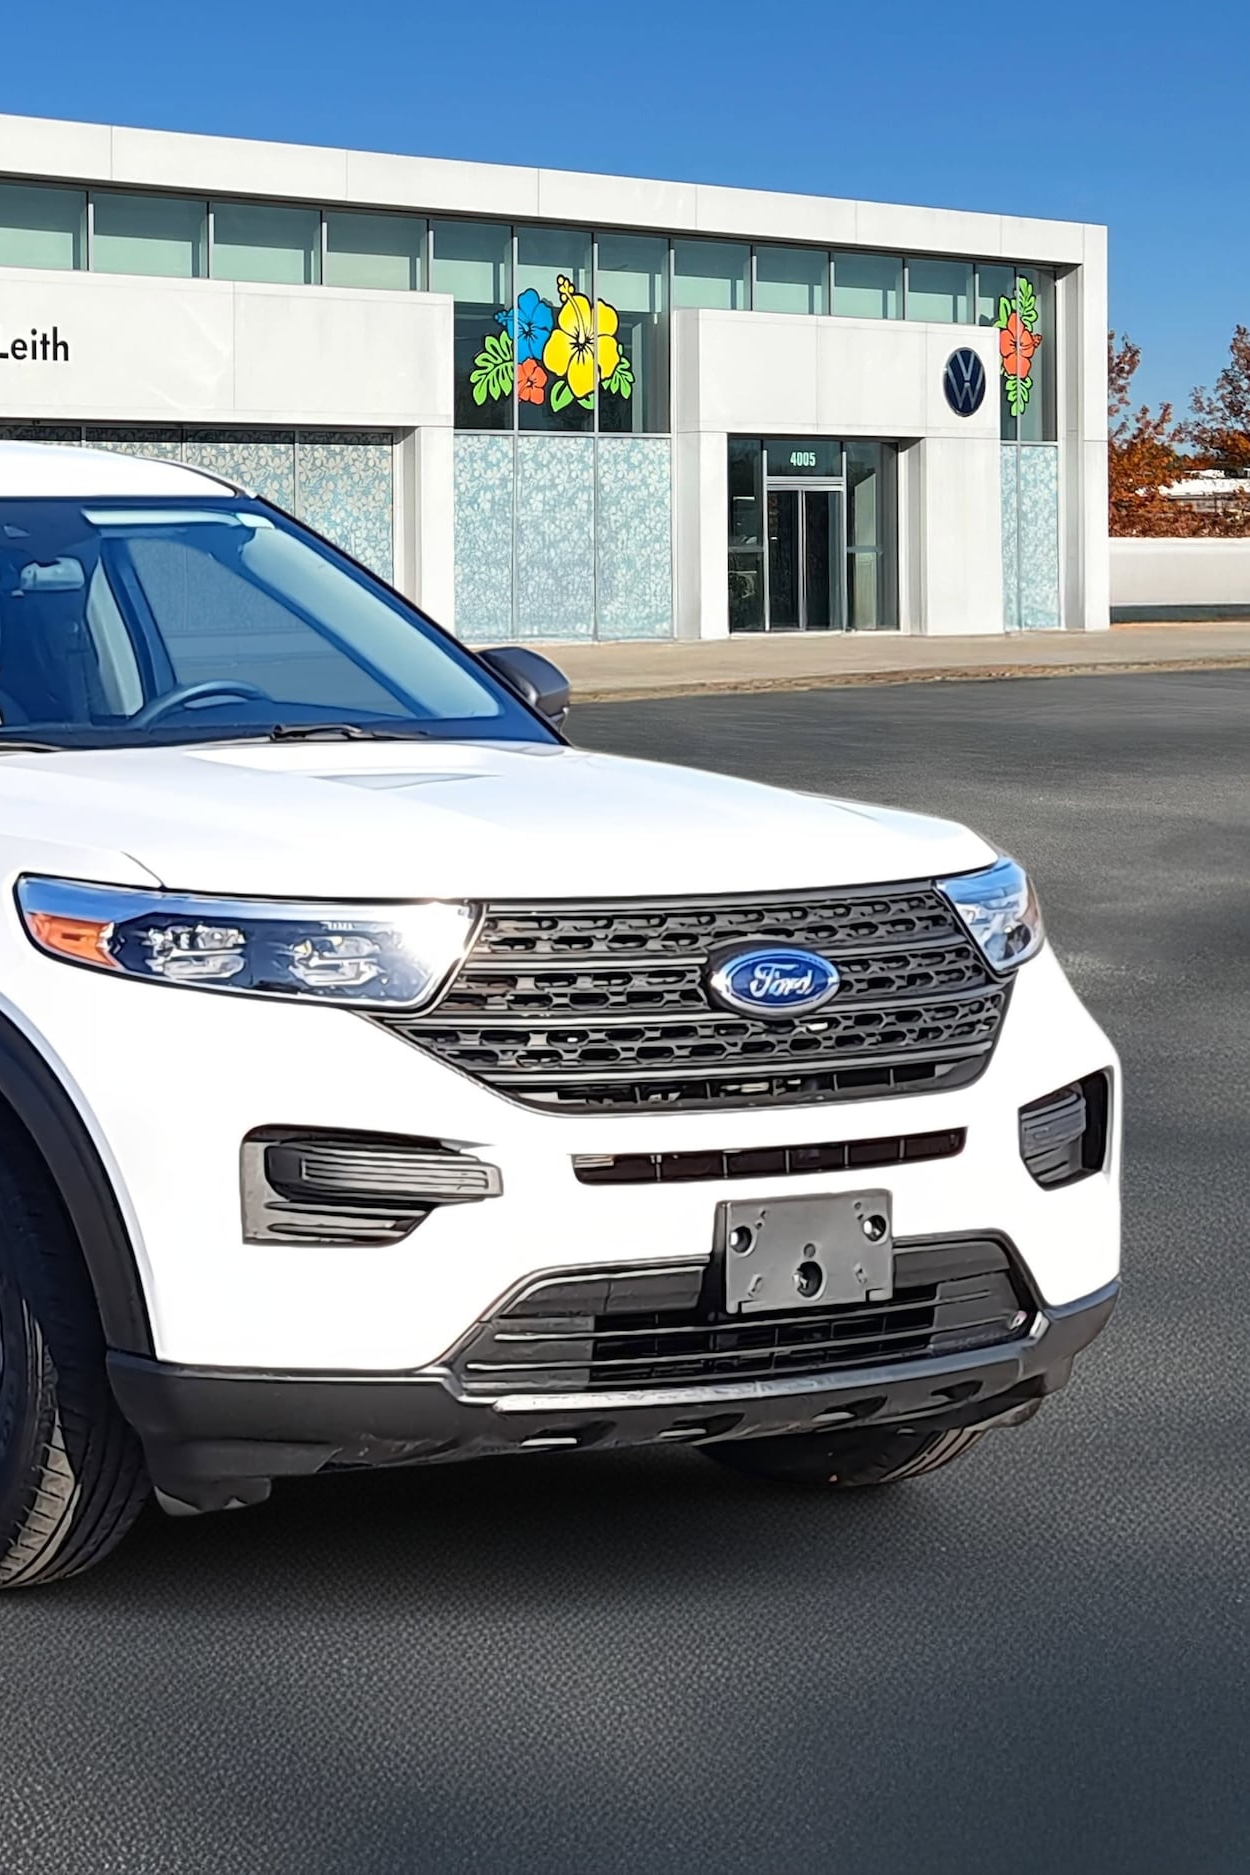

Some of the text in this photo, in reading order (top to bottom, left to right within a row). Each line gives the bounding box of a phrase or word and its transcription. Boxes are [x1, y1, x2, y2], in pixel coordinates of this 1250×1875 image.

[945, 348, 986, 411] VW
[789, 451, 816, 467] 4005
[749, 961, 816, 998] Ford
